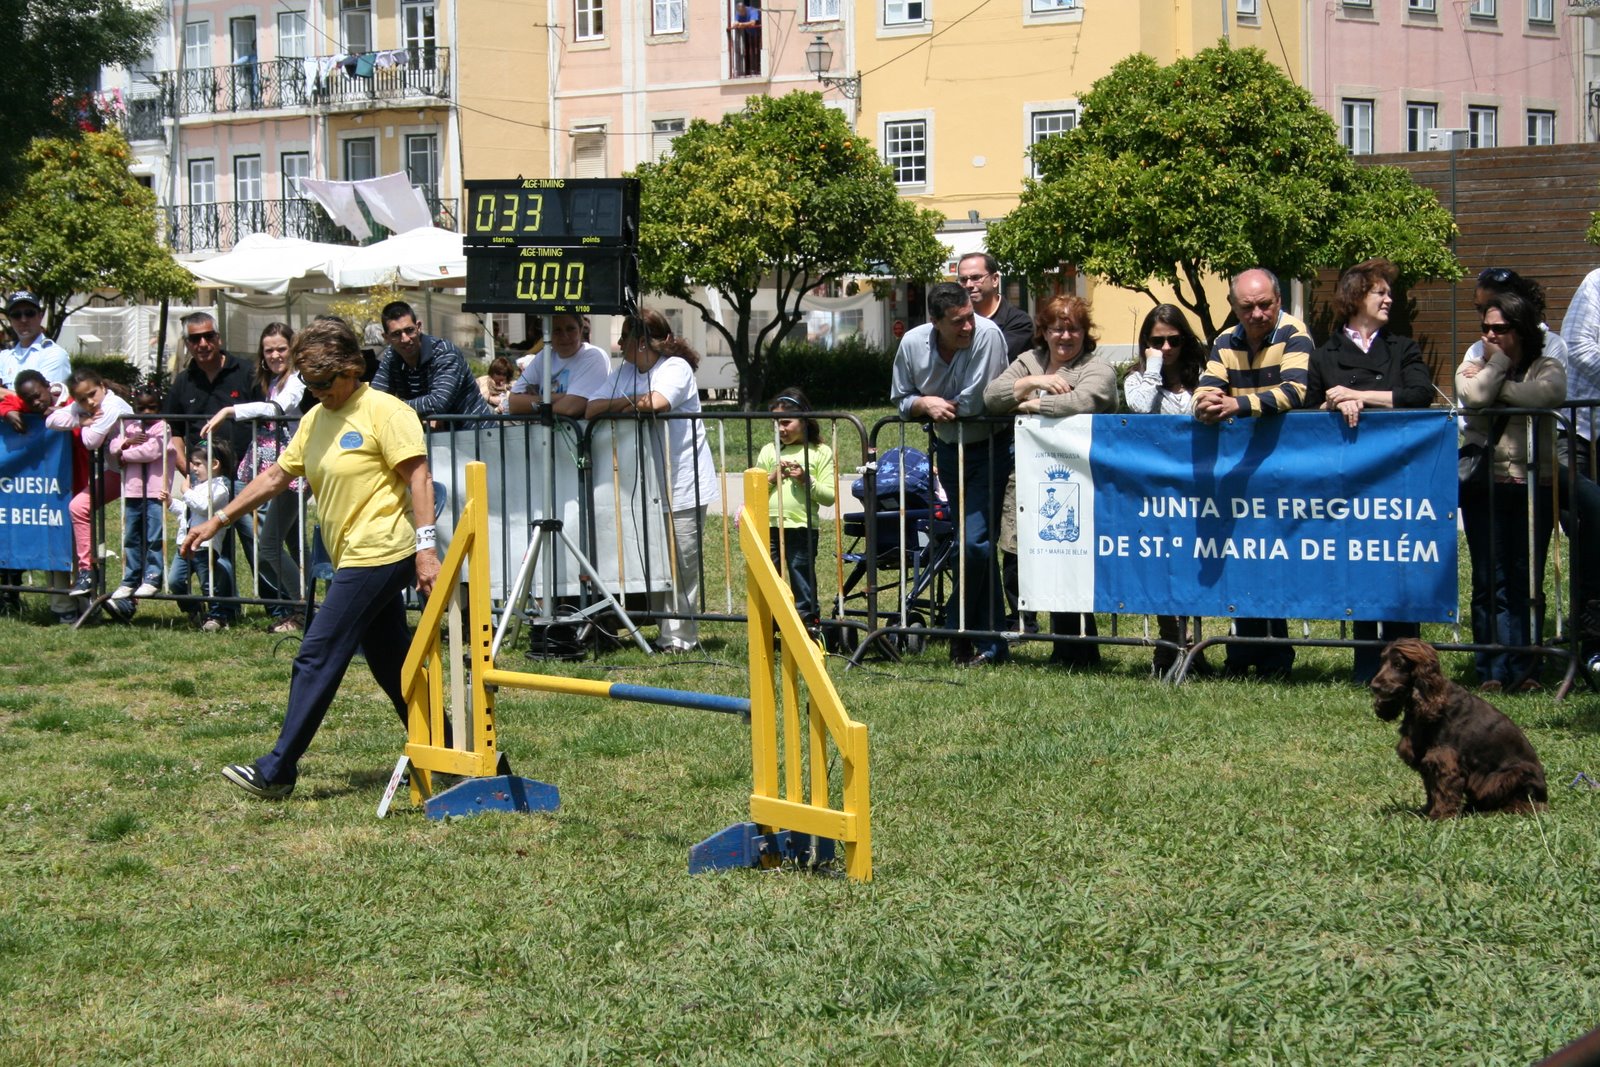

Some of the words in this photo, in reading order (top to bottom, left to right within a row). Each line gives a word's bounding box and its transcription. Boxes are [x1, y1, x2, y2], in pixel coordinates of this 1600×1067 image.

[521, 179, 565, 189] ALGE-TIMING
[475, 194, 543, 231] 033
[520, 248, 563, 257] ALGE-TIMING
[0, 477, 61, 495] GUESIA
[11, 503, 63, 526] BELÉM
[1138, 496, 1221, 518] JUNTA
[1231, 497, 1267, 519] DE
[1277, 498, 1437, 521] FREGUESIA
[1099, 535, 1130, 557] DE
[1193, 537, 1289, 560] MARIA
[1301, 538, 1336, 561] DE
[1348, 533, 1440, 563] BELÉM
